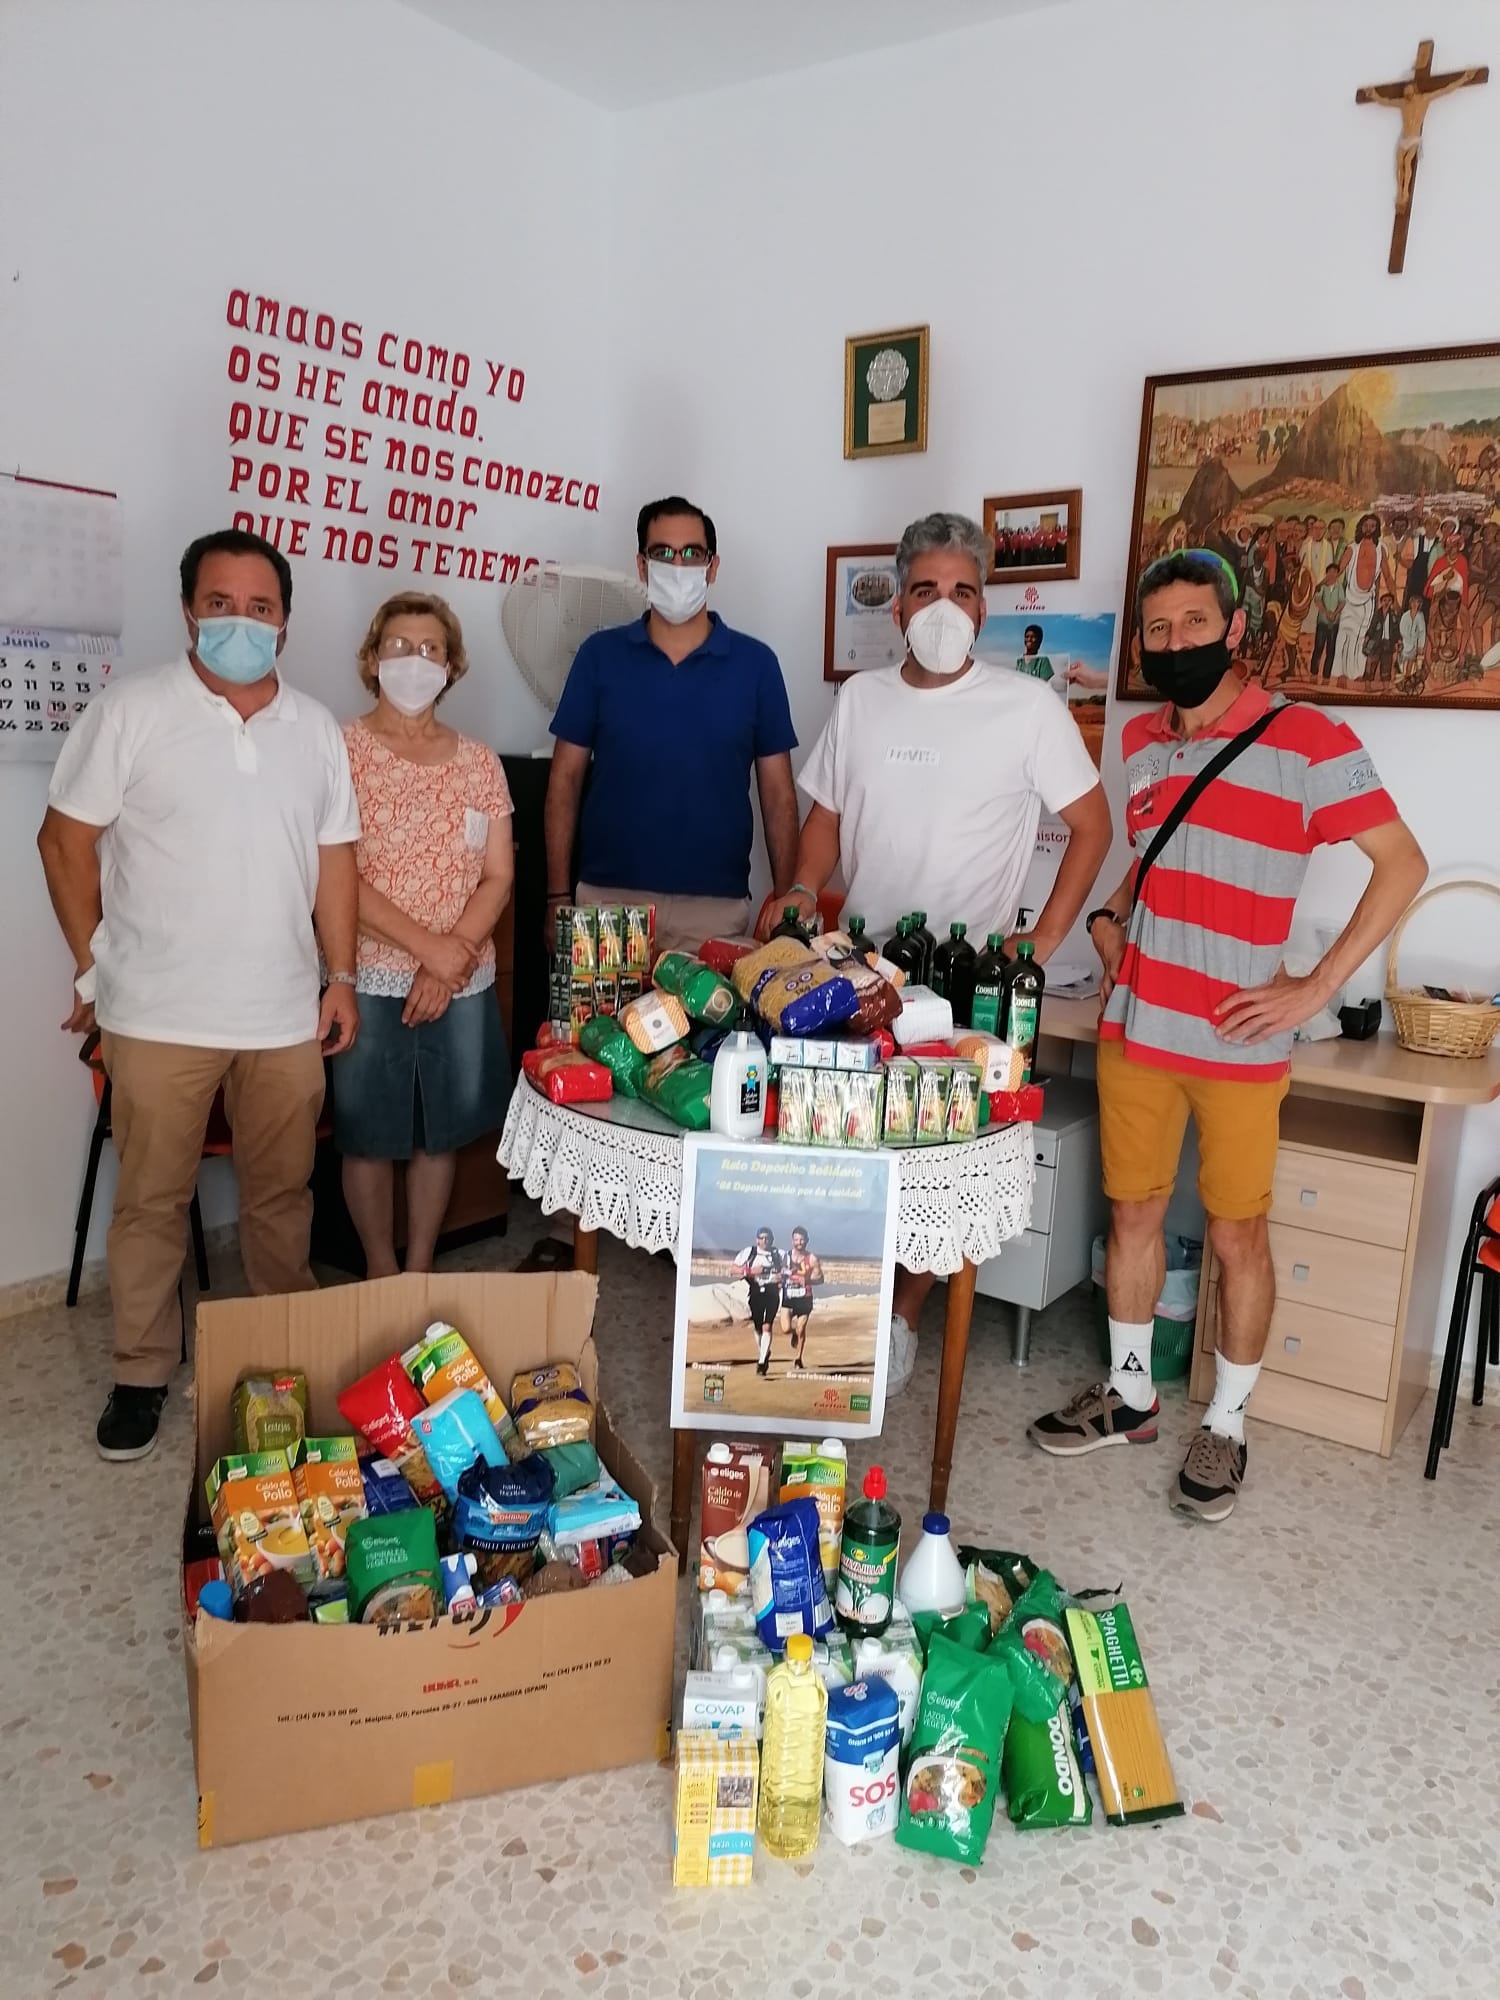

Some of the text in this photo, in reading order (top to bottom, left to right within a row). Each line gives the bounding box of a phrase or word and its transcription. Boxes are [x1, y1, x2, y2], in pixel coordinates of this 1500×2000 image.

[228, 345, 281, 391] OS
[296, 360, 346, 407] HE
[484, 359, 526, 402] YO
[229, 401, 308, 451] QUE
[324, 423, 372, 464] SE
[229, 456, 311, 506] POR
[324, 474, 369, 515] EL
[2, 636, 51, 649] Junio
[24, 658, 36, 670] 4
[51, 661, 61, 672] 5
[77, 662, 88, 673] 6
[101, 664, 111, 675] 7
[24, 679, 38, 691] 11
[49, 680, 65, 692] 12
[76, 681, 91, 693] 13
[24, 699, 41, 711] 18
[51, 700, 67, 712] 19
[25, 720, 43, 731] 25
[51, 721, 70, 732] 26
[750, 1160, 806, 1176] Deportivo
[719, 1467, 745, 1480] eliges
[255, 1479, 290, 1493] Caldo de
[335, 1476, 361, 1489] Pollo
[263, 1488, 293, 1503] Pollo
[707, 1486, 733, 1498] Caldo
[707, 1494, 730, 1506] Pollo
[1100, 1610, 1130, 1687] SPAGHETTI
[694, 1703, 745, 1716] COVAP
[849, 1772, 896, 1808] SOS
